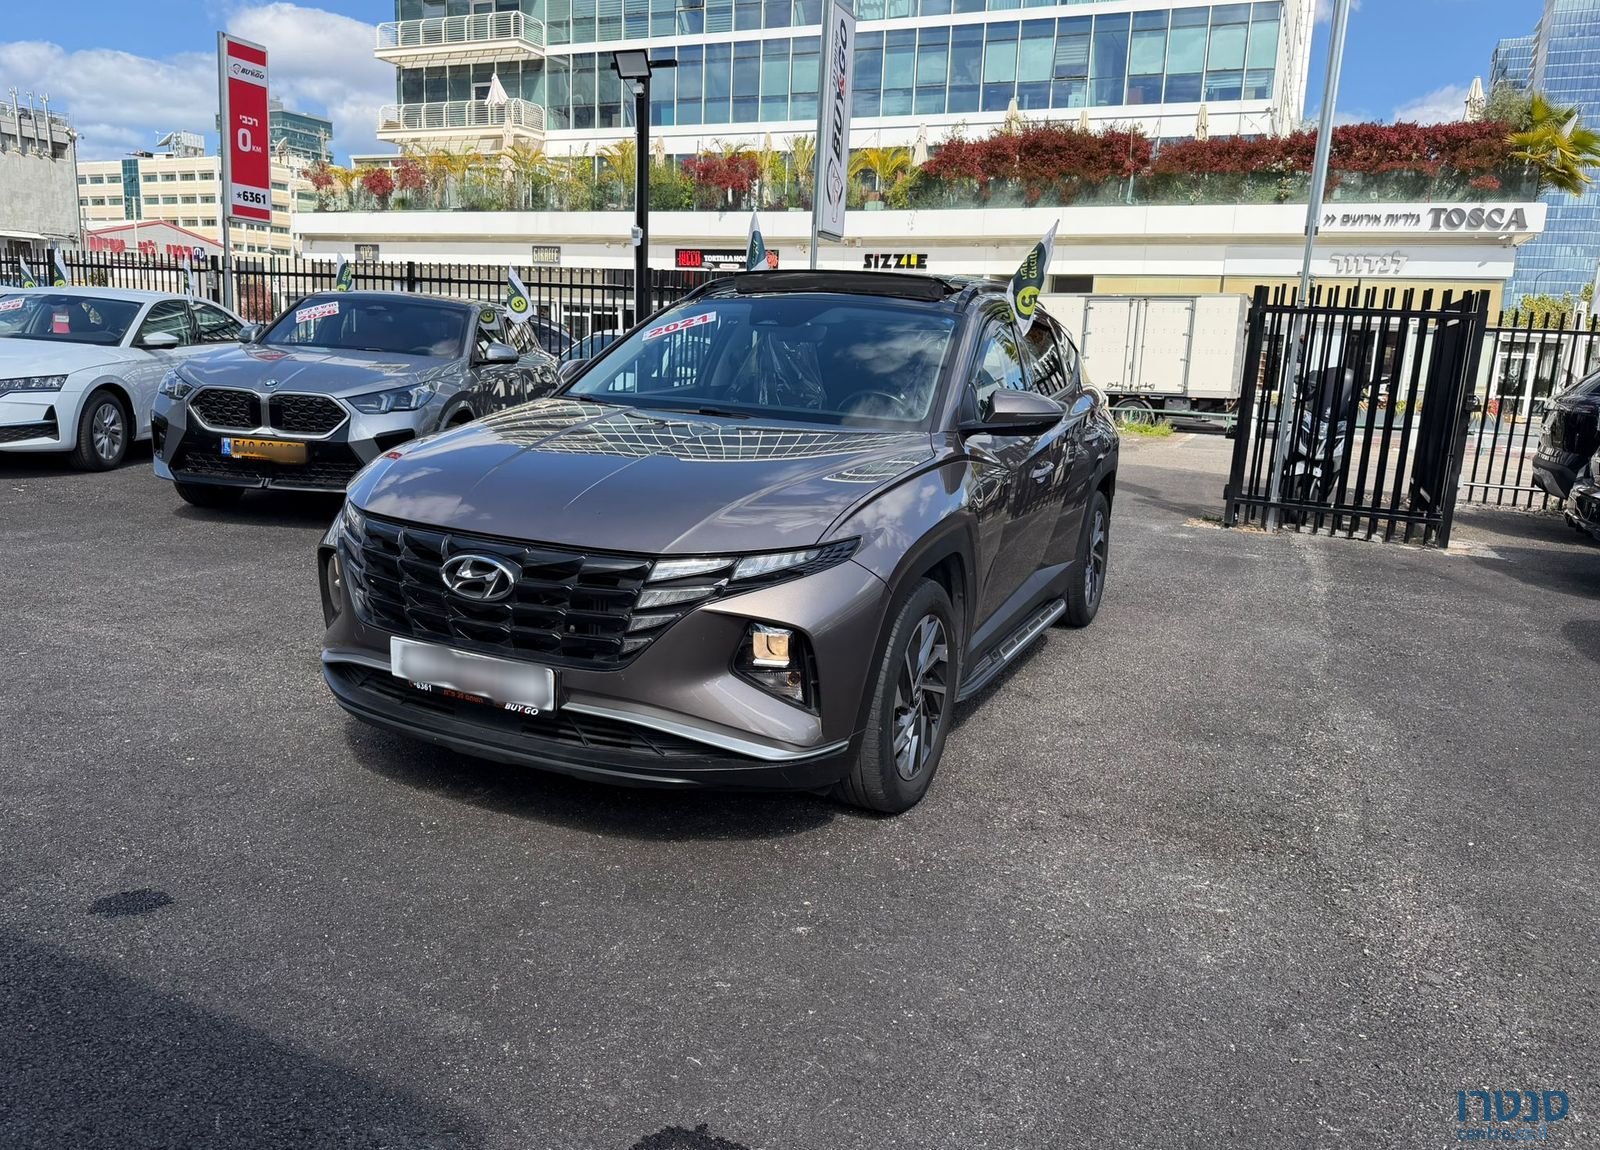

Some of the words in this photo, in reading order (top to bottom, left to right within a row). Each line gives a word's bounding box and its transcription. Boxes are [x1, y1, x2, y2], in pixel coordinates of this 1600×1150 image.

[831, 18, 848, 163] BUY&GO
[239, 114, 259, 127] רכבי
[237, 127, 252, 152] 0
[252, 144, 262, 153] KM
[1341, 213, 1382, 226] אירועים
[1384, 212, 1421, 226] גלריות
[1427, 207, 1528, 231] TOSCA
[703, 254, 733, 263] TORTILLA
[863, 253, 928, 269] SIZZLE
[1330, 251, 1408, 275] לנדוור
[1020, 294, 1038, 308] 5
[648, 314, 709, 338] 2021
